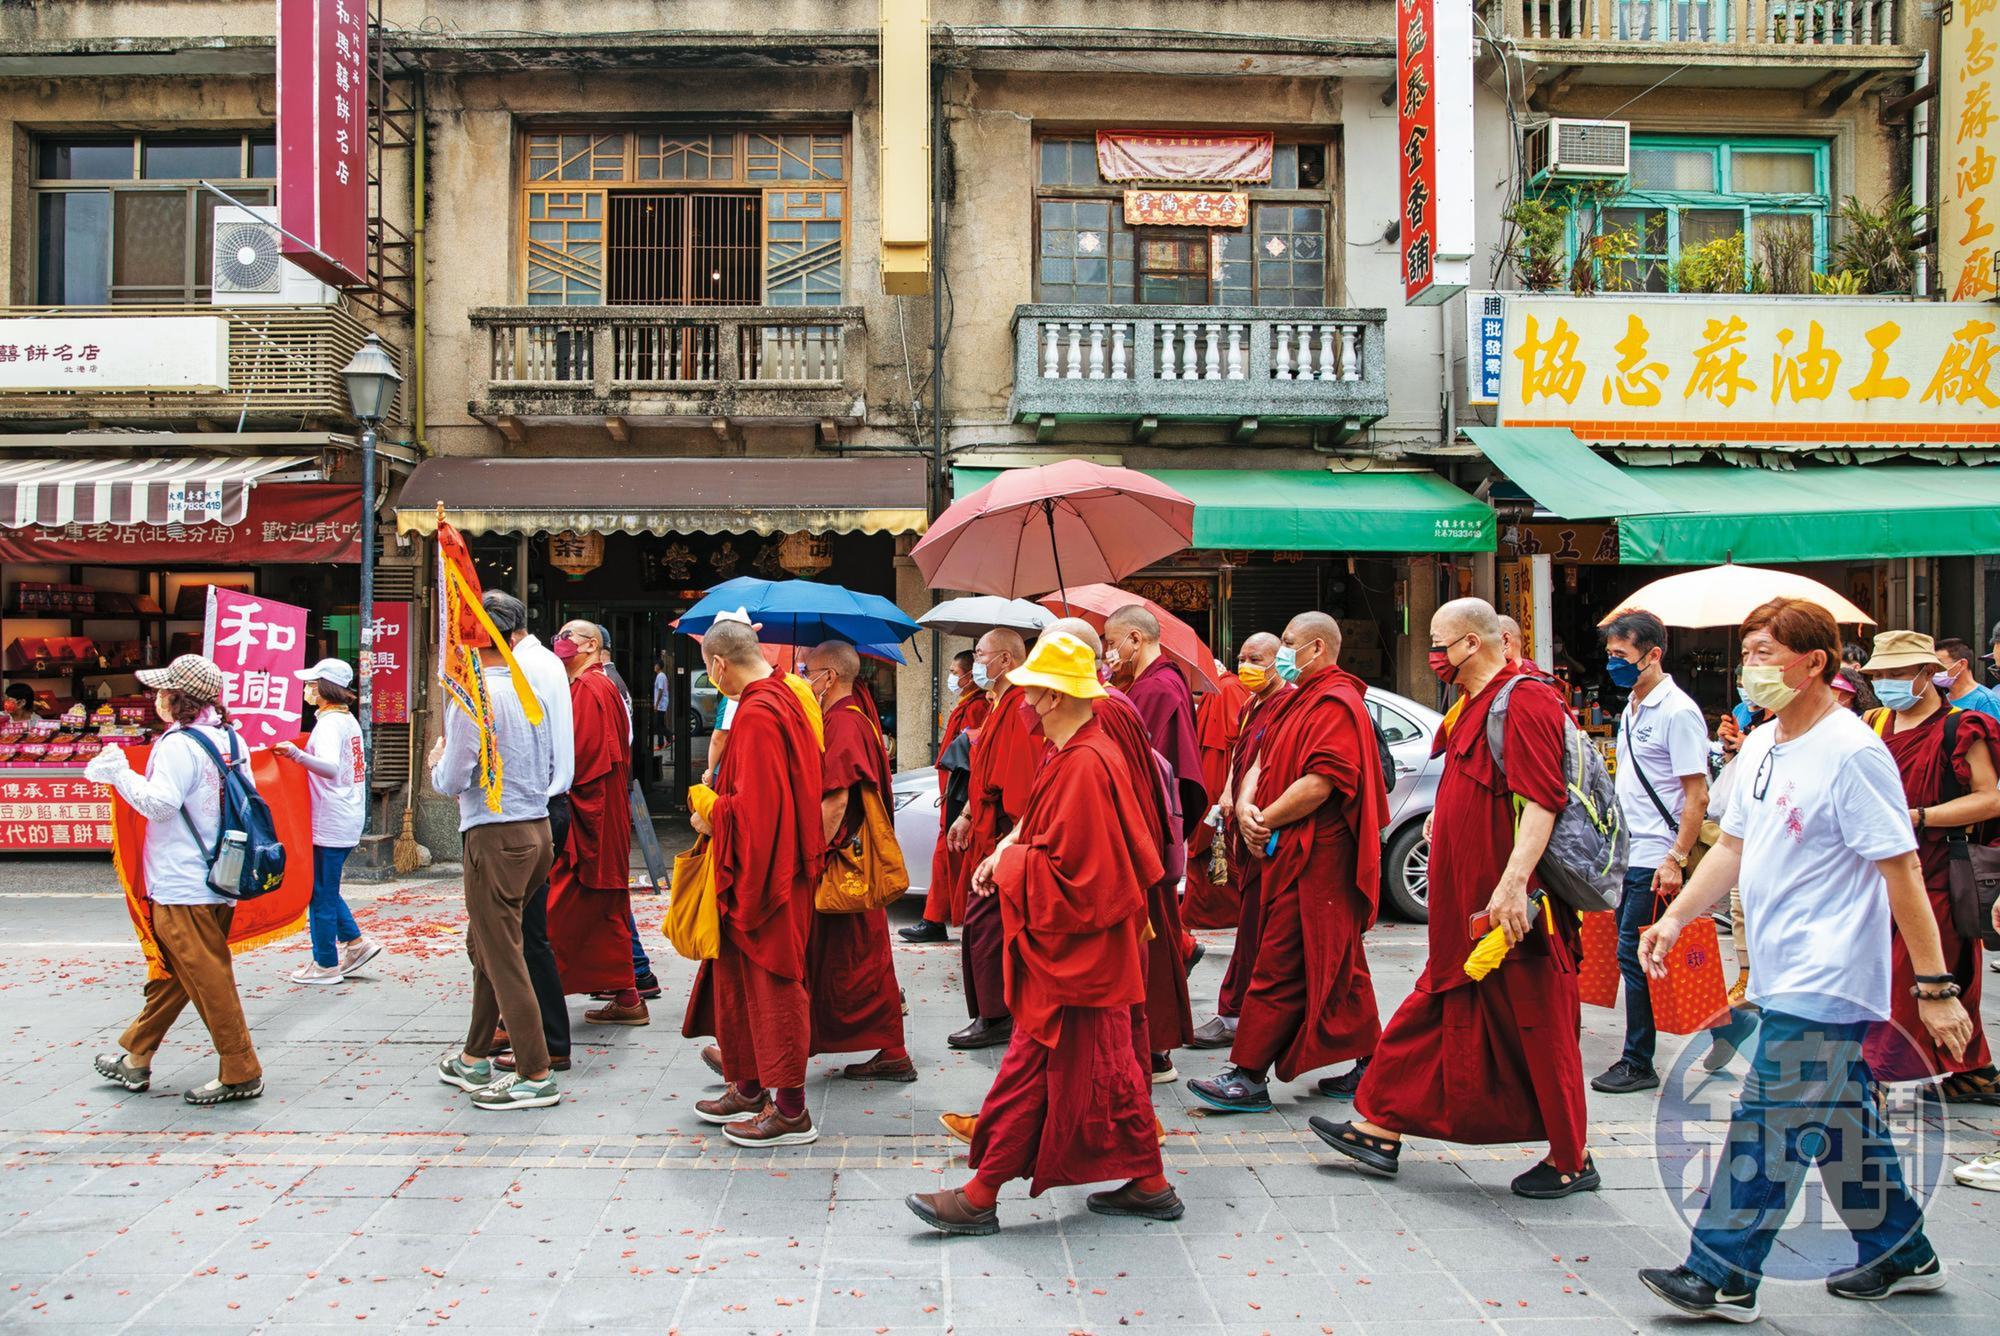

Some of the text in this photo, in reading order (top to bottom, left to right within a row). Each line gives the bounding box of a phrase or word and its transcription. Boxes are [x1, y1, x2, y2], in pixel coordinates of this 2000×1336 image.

[64, 365, 98, 374] 北港店
[216, 602, 302, 752] 和興
